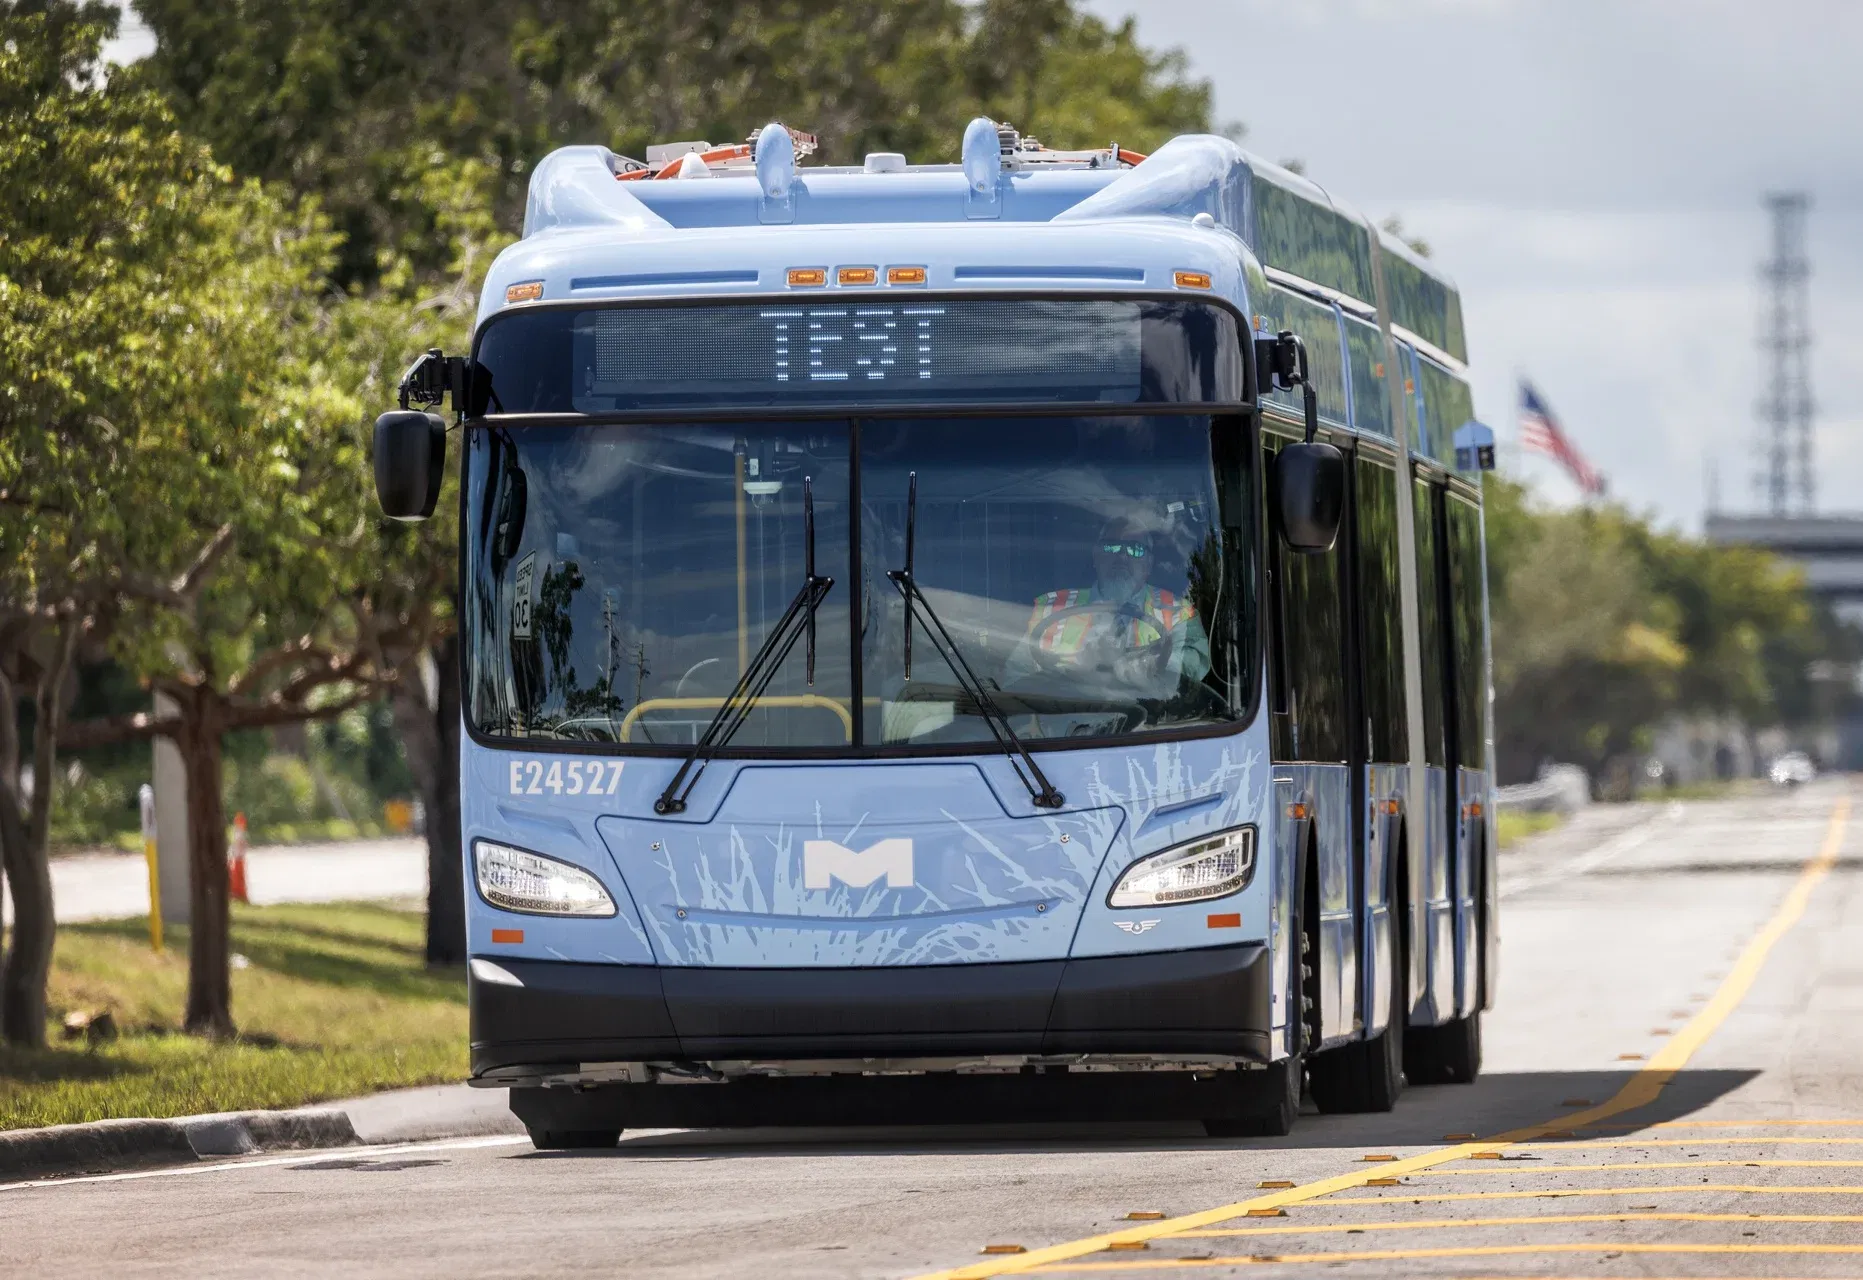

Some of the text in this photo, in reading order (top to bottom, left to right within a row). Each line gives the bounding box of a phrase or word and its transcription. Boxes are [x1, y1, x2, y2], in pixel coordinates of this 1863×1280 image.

[761, 309, 945, 381] TEST
[510, 760, 625, 795] E24527
[803, 838, 914, 889] M
